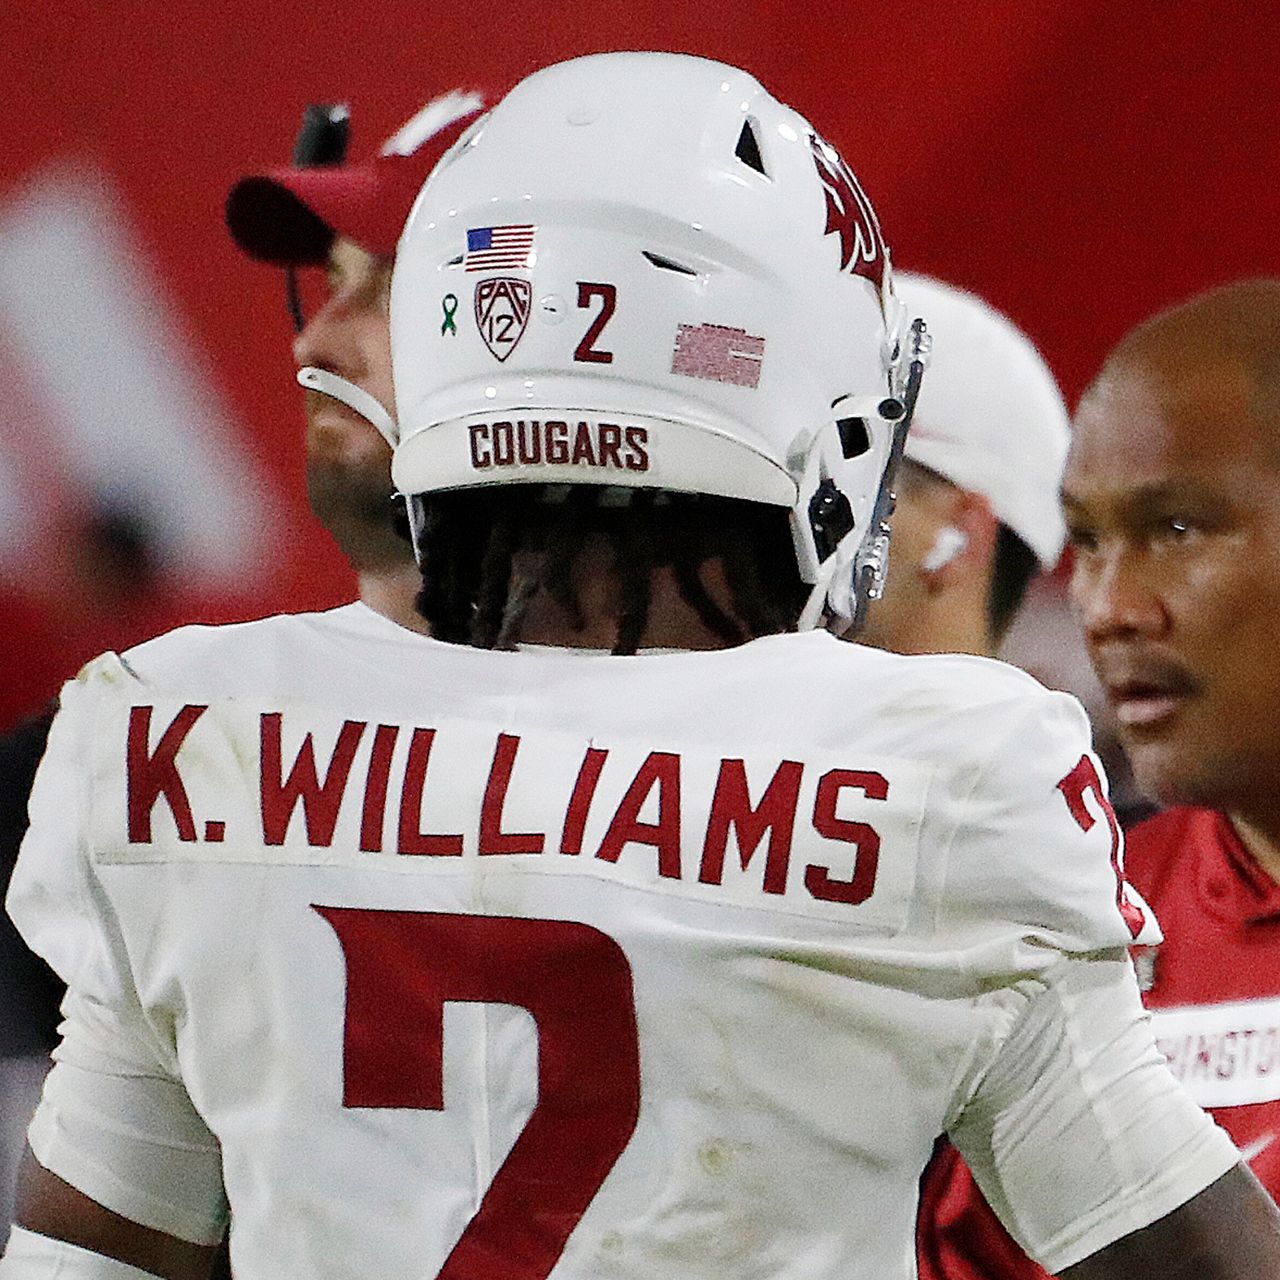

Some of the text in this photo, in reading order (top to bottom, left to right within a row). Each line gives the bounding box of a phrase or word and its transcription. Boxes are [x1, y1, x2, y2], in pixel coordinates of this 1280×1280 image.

[573, 281, 618, 364] 2
[467, 420, 650, 473] COUGARS
[125, 704, 890, 907] K.WILLIAMS
